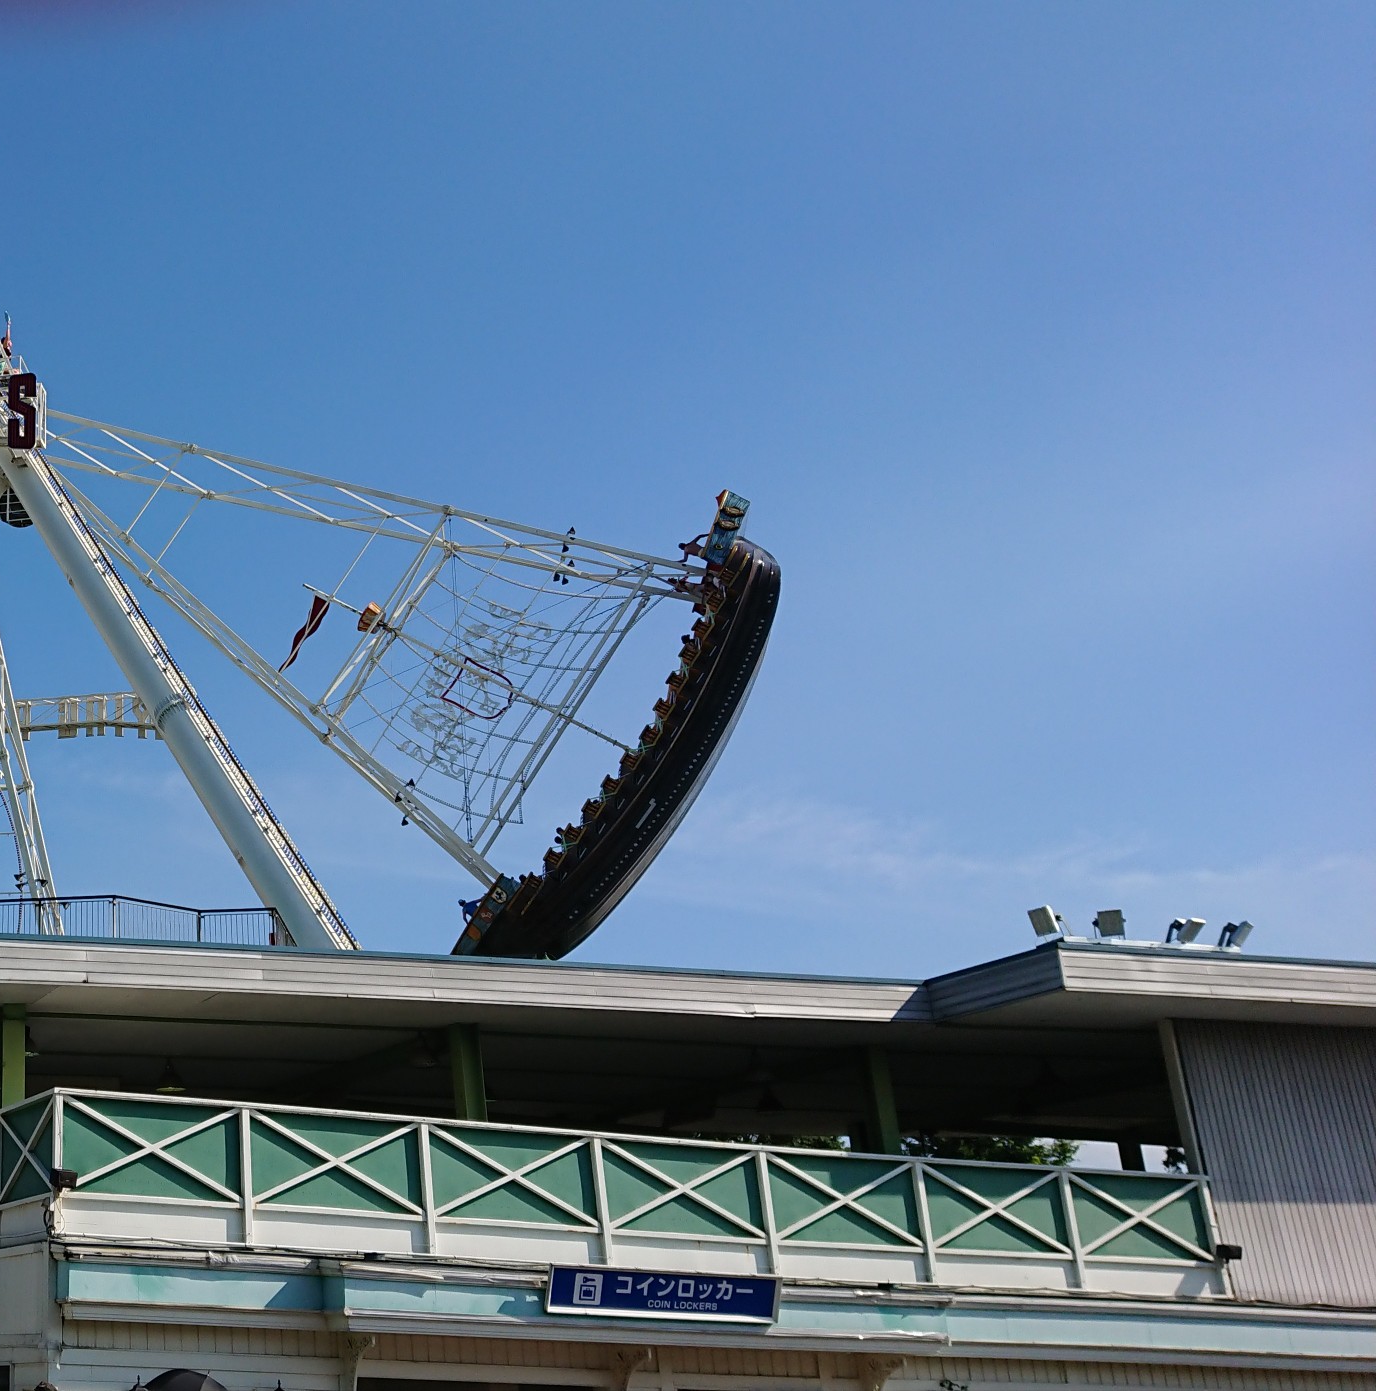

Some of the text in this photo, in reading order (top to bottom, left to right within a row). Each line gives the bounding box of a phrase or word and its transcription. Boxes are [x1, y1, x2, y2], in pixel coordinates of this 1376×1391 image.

[615, 1276, 754, 1300] コインロッカー
[647, 1299, 718, 1311] COIN LOCKERS
